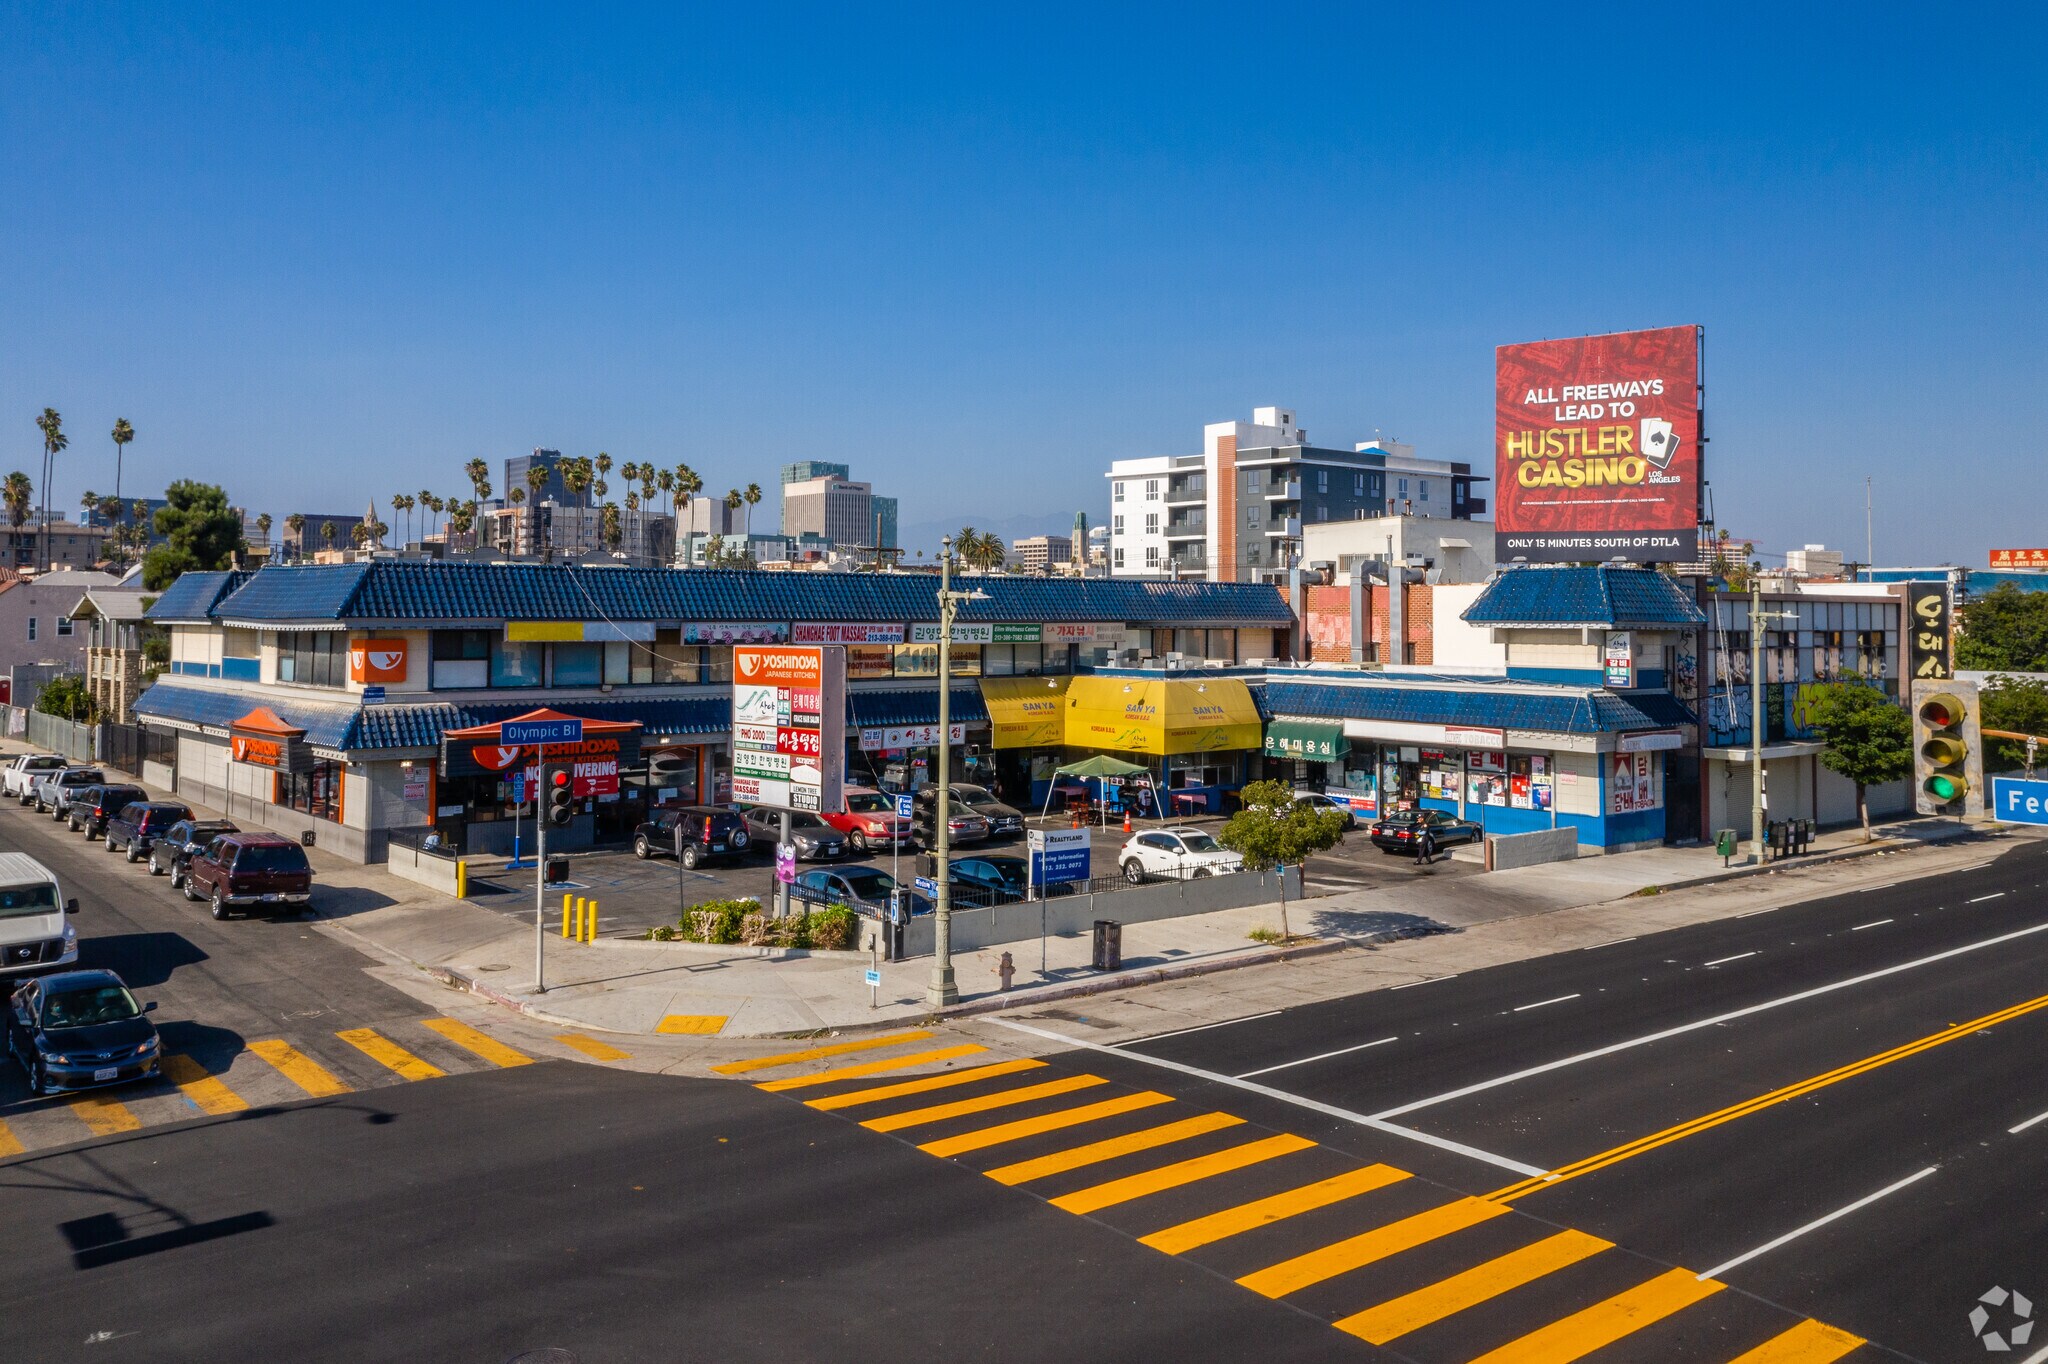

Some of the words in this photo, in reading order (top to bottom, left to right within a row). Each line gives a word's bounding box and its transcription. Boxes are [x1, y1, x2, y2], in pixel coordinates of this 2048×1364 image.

[1524, 387, 1559, 405] ALL
[1563, 379, 1664, 402] FREEWAYS
[1555, 404, 1604, 422] LEAD
[1608, 402, 1635, 418] TO
[1507, 425, 1634, 460] HUSTLER
[1517, 456, 1646, 488] CASINO
[1649, 475, 1681, 484] ANGELES
[1507, 539, 1533, 548] ONLY
[1536, 539, 1546, 548] 15
[1548, 538, 1591, 548] MINUTES
[1594, 538, 1629, 548] SOUTH
[1632, 538, 1648, 547] OF
[1651, 538, 1680, 547] DTLA
[795, 626, 824, 642] SHANGHAE
[826, 626, 840, 642] FOOT
[841, 626, 868, 642] MASSAGE
[762, 655, 818, 670] YOSHINOYA
[765, 670, 792, 678] JAPANESE
[793, 671, 816, 679] KITCHEN
[760, 701, 776, 714] 산야
[793, 694, 820, 710] 은혜미용실
[1022, 702, 1040, 710] SAN
[1126, 704, 1142, 712] SAN
[1143, 705, 1156, 714] YA
[1192, 706, 1210, 715] SAN
[508, 726, 558, 741] Olympic
[564, 725, 576, 736] Bl
[752, 730, 766, 740] 2000
[864, 731, 880, 740] 김밥
[906, 726, 960, 740] 서울집
[778, 732, 819, 752] 서울떡집
[1266, 736, 1330, 754] 은혜미용실
[578, 754, 615, 763] KITCHEN
[734, 785, 760, 795] MASSAGE
[793, 794, 818, 805] STUDIO
[1050, 834, 1083, 843] REALTYLAND
